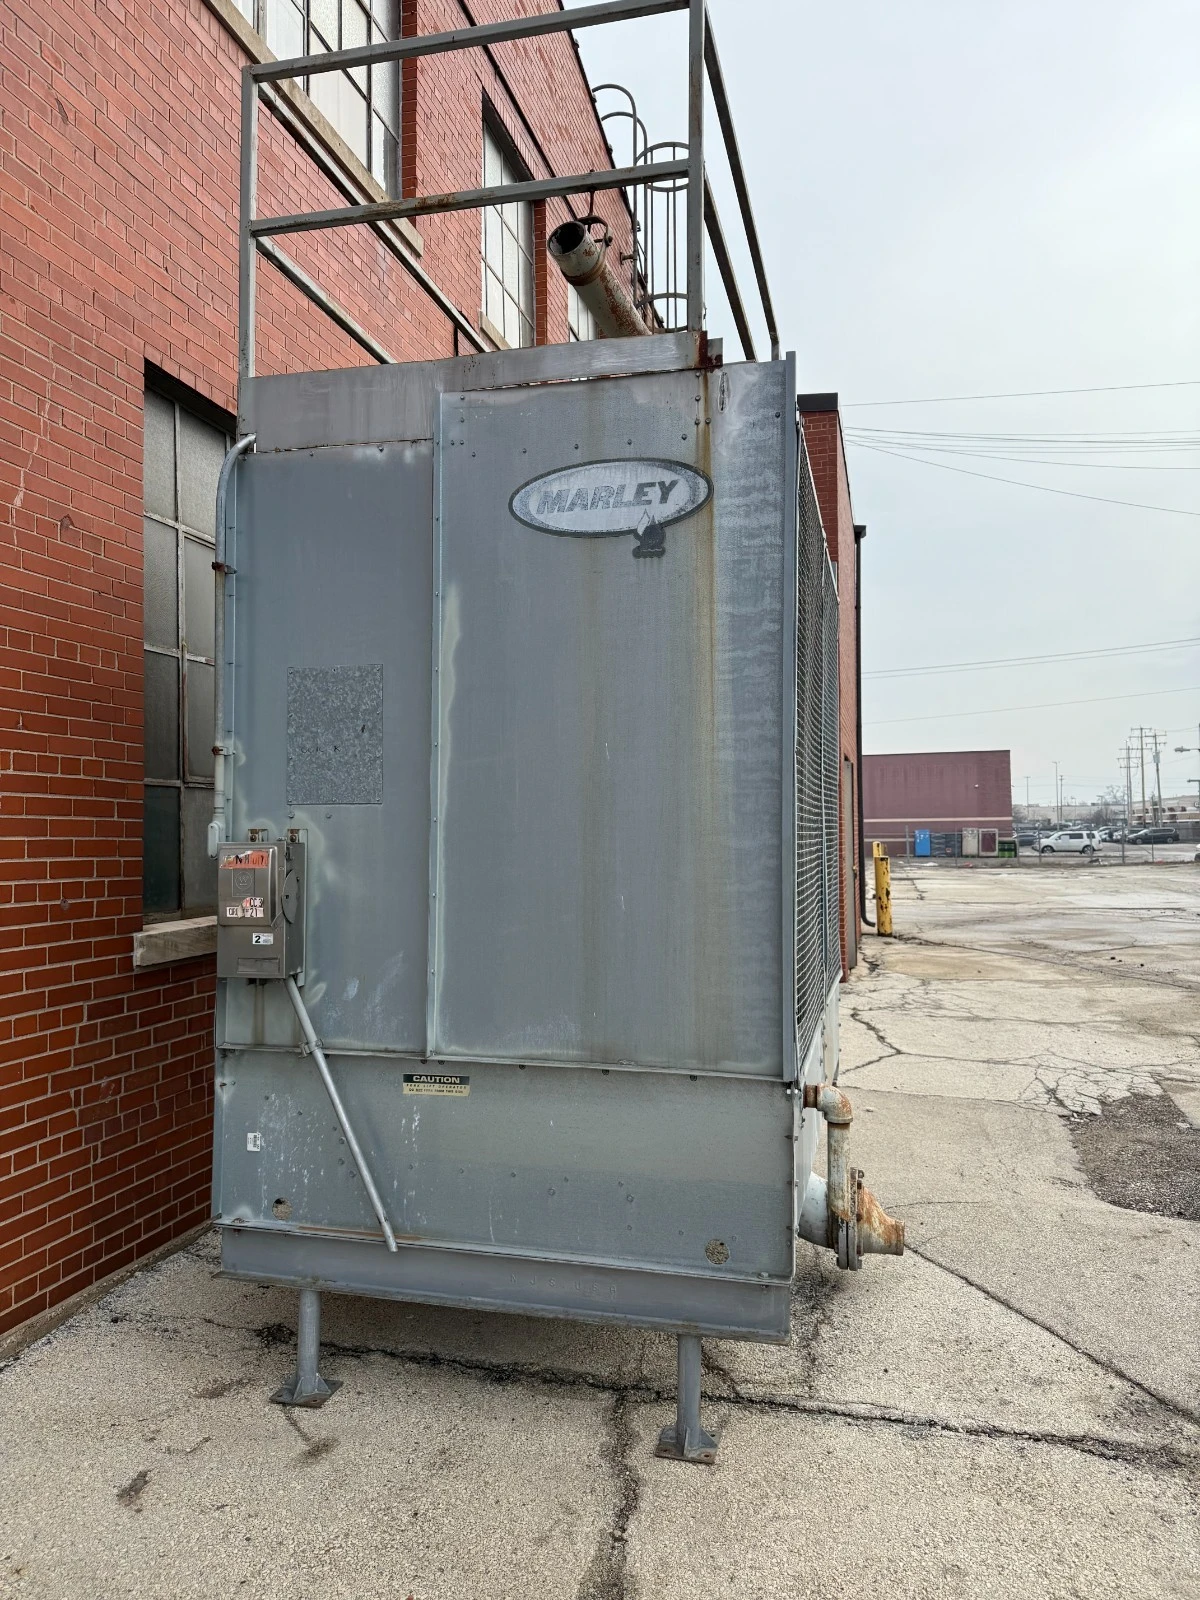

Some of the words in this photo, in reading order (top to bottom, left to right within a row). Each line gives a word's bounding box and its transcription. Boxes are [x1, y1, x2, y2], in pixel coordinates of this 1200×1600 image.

[536, 479, 680, 514] MARLEY
[254, 935, 261, 944] 2
[413, 1076, 460, 1084] CAUTION
